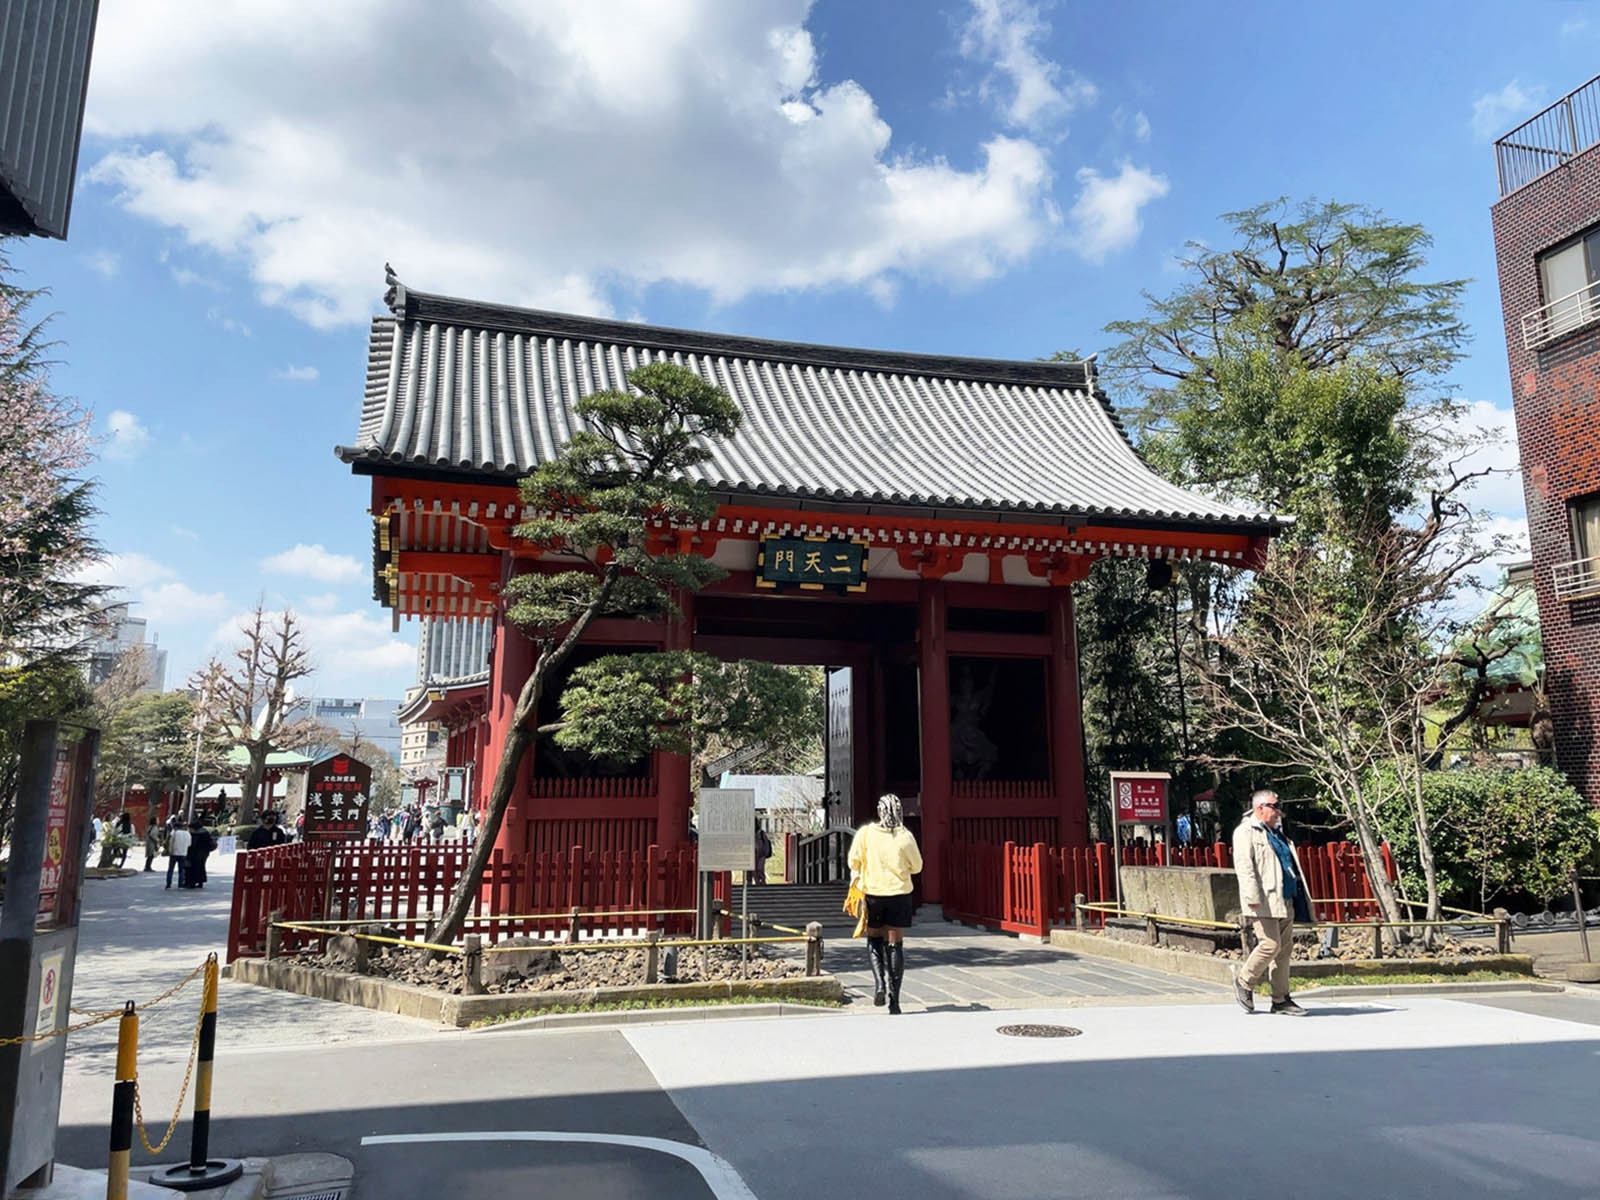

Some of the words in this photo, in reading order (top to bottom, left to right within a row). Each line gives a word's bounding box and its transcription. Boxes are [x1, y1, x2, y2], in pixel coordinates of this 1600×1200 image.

[308, 792, 367, 807] 浅草寺
[313, 809, 360, 820] 二天門
